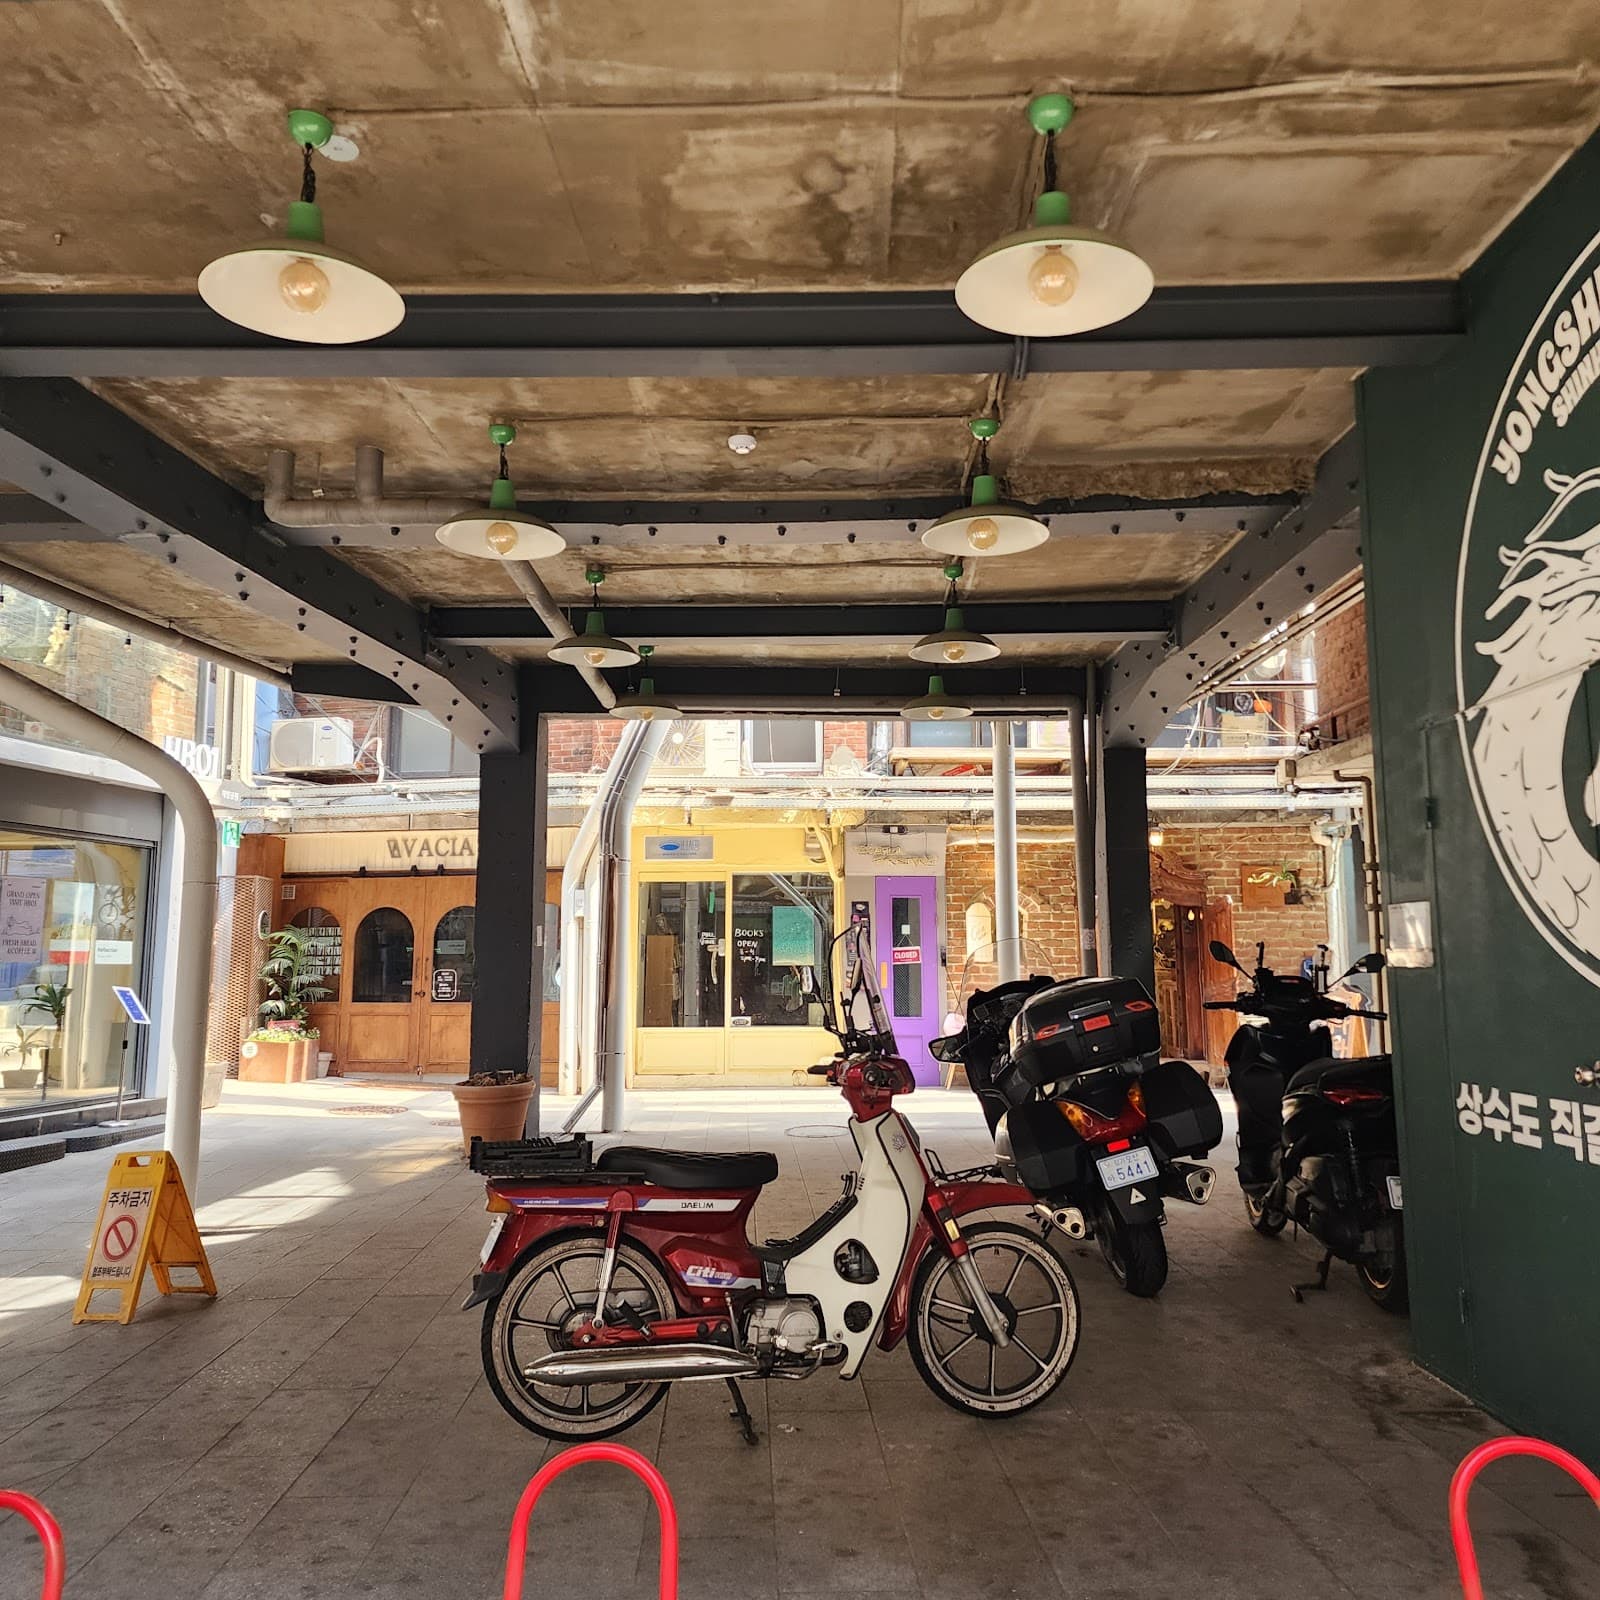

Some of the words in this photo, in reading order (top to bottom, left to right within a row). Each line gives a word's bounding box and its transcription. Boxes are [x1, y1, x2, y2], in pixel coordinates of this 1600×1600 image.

[735, 928, 764, 937] BOOKS
[894, 951, 918, 959] CLOSED
[1455, 1081, 1543, 1150] 상수도
[1116, 1160, 1151, 1180] 5441
[108, 1190, 152, 1208] 주차금지
